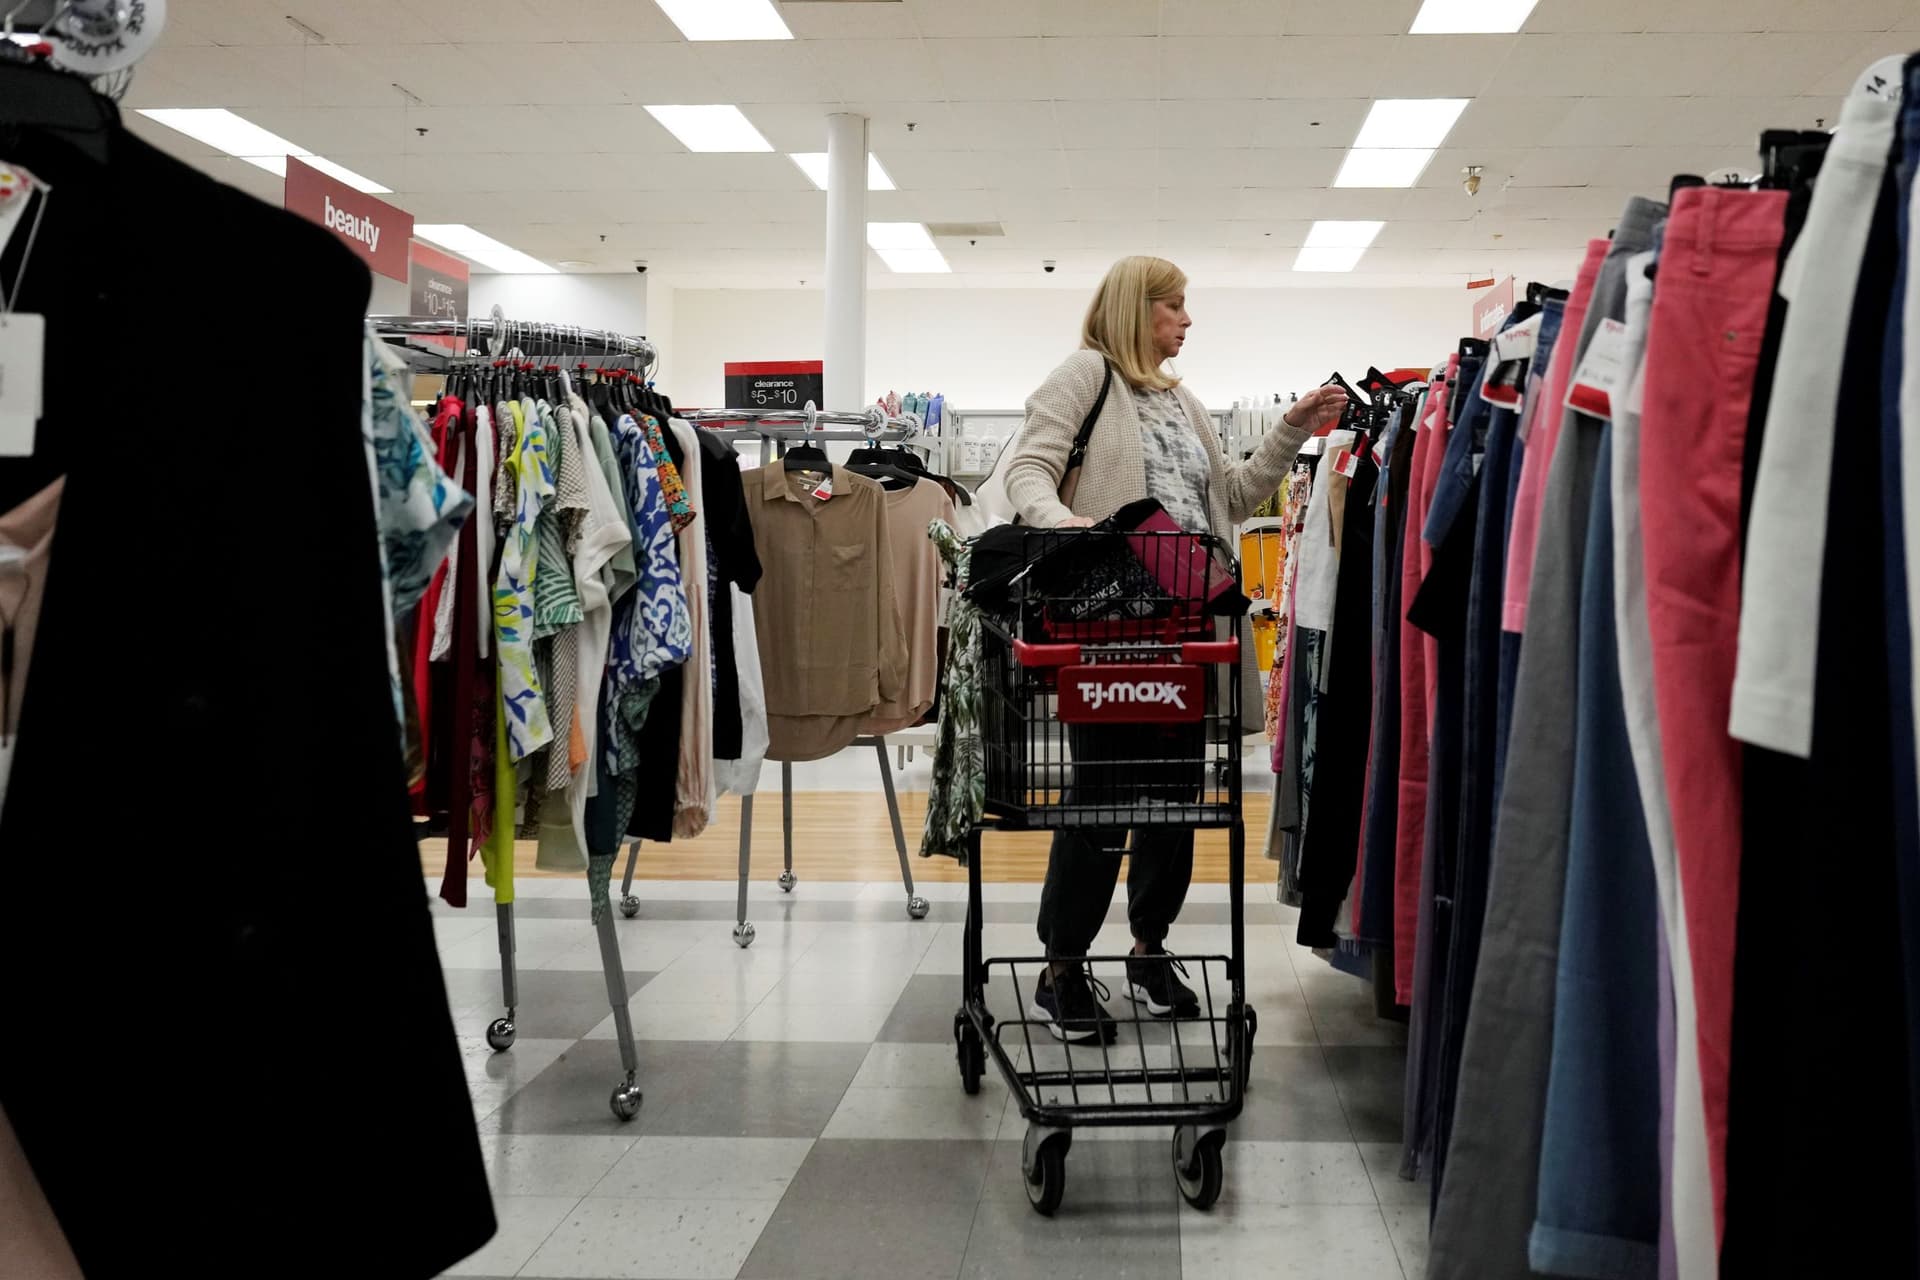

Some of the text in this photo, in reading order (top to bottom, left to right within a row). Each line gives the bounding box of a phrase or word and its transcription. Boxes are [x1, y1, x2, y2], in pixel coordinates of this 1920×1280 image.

[1866, 75, 1887, 95] 14
[324, 195, 380, 252] beauty
[428, 278, 454, 295] clearance
[754, 380, 794, 388] clearance
[751, 389, 798, 405] $5-$10
